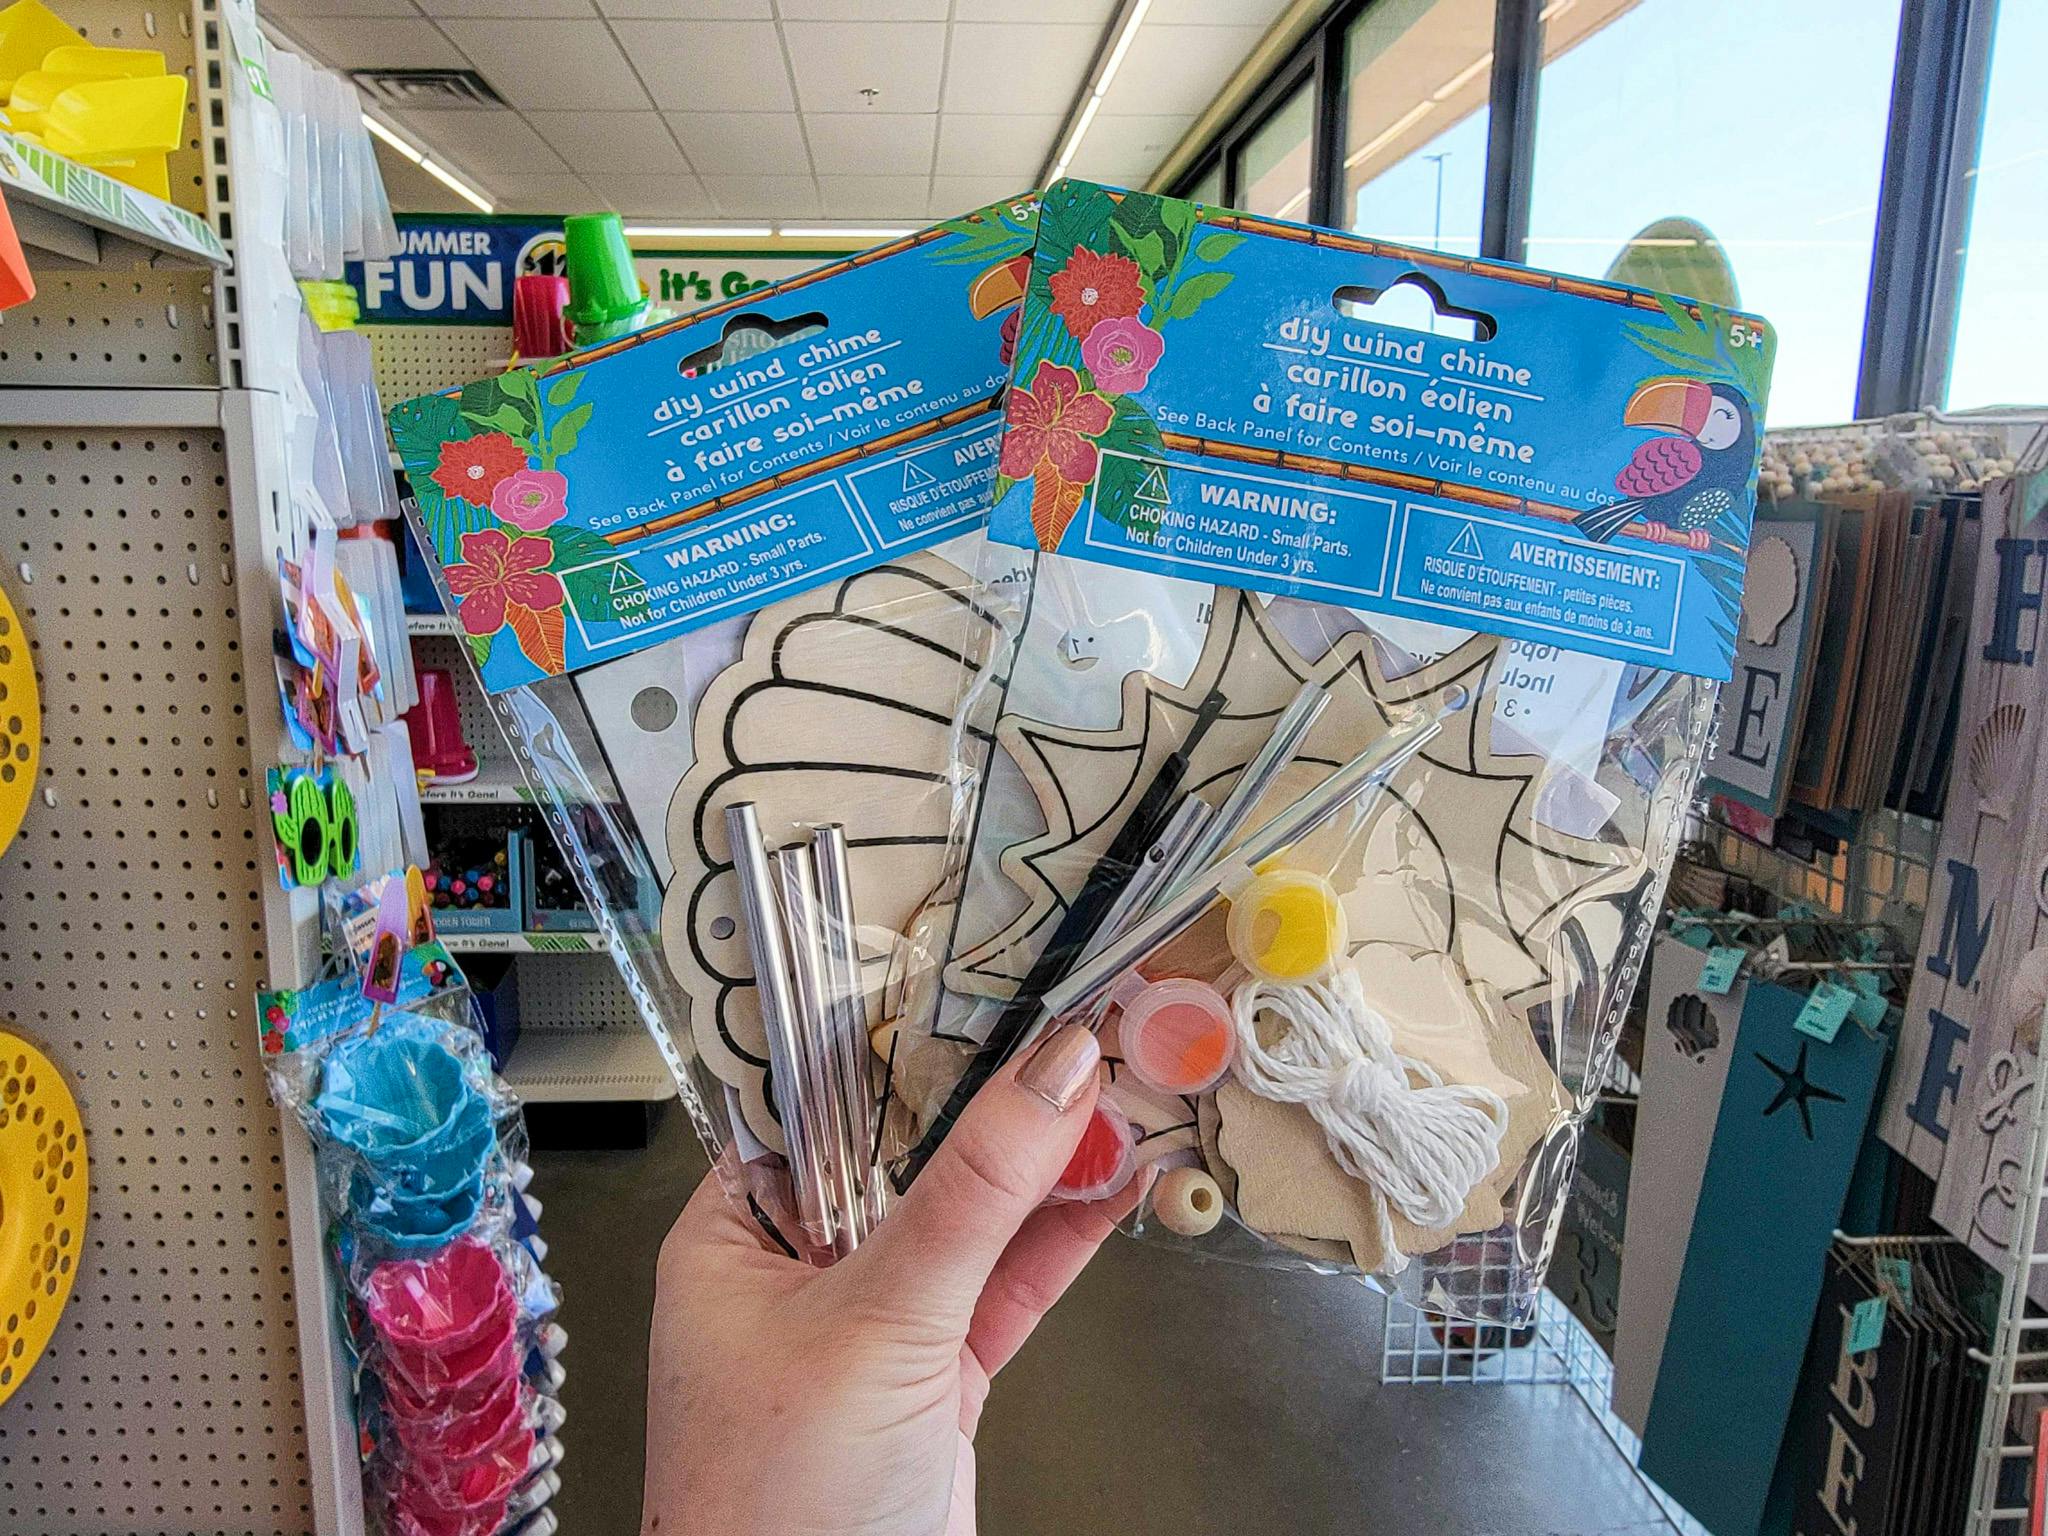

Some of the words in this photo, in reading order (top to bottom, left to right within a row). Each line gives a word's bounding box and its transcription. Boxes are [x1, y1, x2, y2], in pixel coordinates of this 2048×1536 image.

[398, 230, 491, 256] UMMER
[364, 260, 504, 311] FUN
[660, 268, 712, 301] it's
[1279, 317, 1331, 357] diy
[1342, 331, 1425, 365] wind
[1441, 347, 1532, 387] chime
[1728, 323, 1763, 348] 5+
[653, 392, 705, 424] diy
[709, 358, 787, 398] wind
[798, 328, 883, 369] chime
[680, 394, 790, 447] carillon
[801, 361, 887, 401] éolien
[1287, 362, 1407, 403] carillon
[1421, 376, 1513, 425] éolien
[589, 513, 621, 531] See
[626, 497, 668, 521] Back
[671, 476, 718, 505] Panel
[720, 468, 745, 492] for
[749, 438, 824, 474] Contents
[837, 423, 873, 444] Voir
[876, 413, 892, 430] le
[896, 391, 959, 423] contenu
[962, 386, 983, 401] au
[985, 373, 1008, 389] do
[666, 459, 686, 484] à
[694, 434, 763, 471] faire
[772, 377, 925, 443] soi-même
[1253, 382, 1273, 412] à
[1285, 394, 1361, 430] faire
[1369, 411, 1537, 466] soi-même
[1156, 405, 1191, 427] See
[1195, 411, 1237, 434] Back
[1241, 420, 1293, 444] Panel
[1297, 428, 1323, 448] for
[1328, 435, 1409, 466] Contents
[1427, 452, 1463, 475] Voir
[1467, 459, 1483, 477] le
[1486, 464, 1556, 494] contenu
[1560, 484, 1582, 500] au
[1586, 484, 1616, 507] dos
[888, 490, 930, 514] RISQUE
[898, 516, 914, 532] Ne
[917, 502, 958, 526] convient
[959, 496, 977, 512] pas
[1129, 503, 1196, 531] CHOKING
[1199, 515, 1260, 541] HAZARD
[1272, 530, 1310, 550] Small
[1313, 536, 1352, 557] Parts.
[1200, 483, 1338, 526] WARNING:
[663, 513, 798, 570] WARNING:
[1126, 526, 1150, 545] Not
[1152, 530, 1174, 549] for
[1175, 536, 1233, 559] Children
[1237, 549, 1279, 567] Under
[1281, 556, 1290, 569] 3
[1291, 559, 1318, 575] yrs.
[1509, 541, 1662, 590] AVERTISSEMENT:
[612, 577, 680, 612] CHOKING
[684, 561, 740, 593] HAZARD
[751, 543, 785, 567] Small
[788, 531, 827, 556] Parts.
[619, 609, 644, 630] Not
[645, 602, 668, 623] for
[670, 583, 726, 617] Children
[728, 571, 769, 599] Under
[771, 566, 781, 580] 3
[783, 560, 809, 583] yrs.
[1423, 555, 1466, 578] RISQUE
[1467, 563, 1558, 597] D'ÉTOUFFEMENT
[1563, 587, 1598, 606] petites
[1599, 593, 1634, 613] pièces.
[408, 621, 436, 630] efore
[1421, 578, 1436, 594] Ne
[1437, 584, 1482, 604] convient
[1483, 594, 1503, 609] pas
[1505, 598, 1524, 612] aux
[1525, 601, 1562, 622] enfants
[1564, 608, 1577, 623] de
[1578, 613, 1609, 630] moins
[1610, 619, 1624, 633] de
[1625, 624, 1633, 636] 3
[1633, 626, 1655, 640] ans.
[467, 789, 499, 799] Gone!
